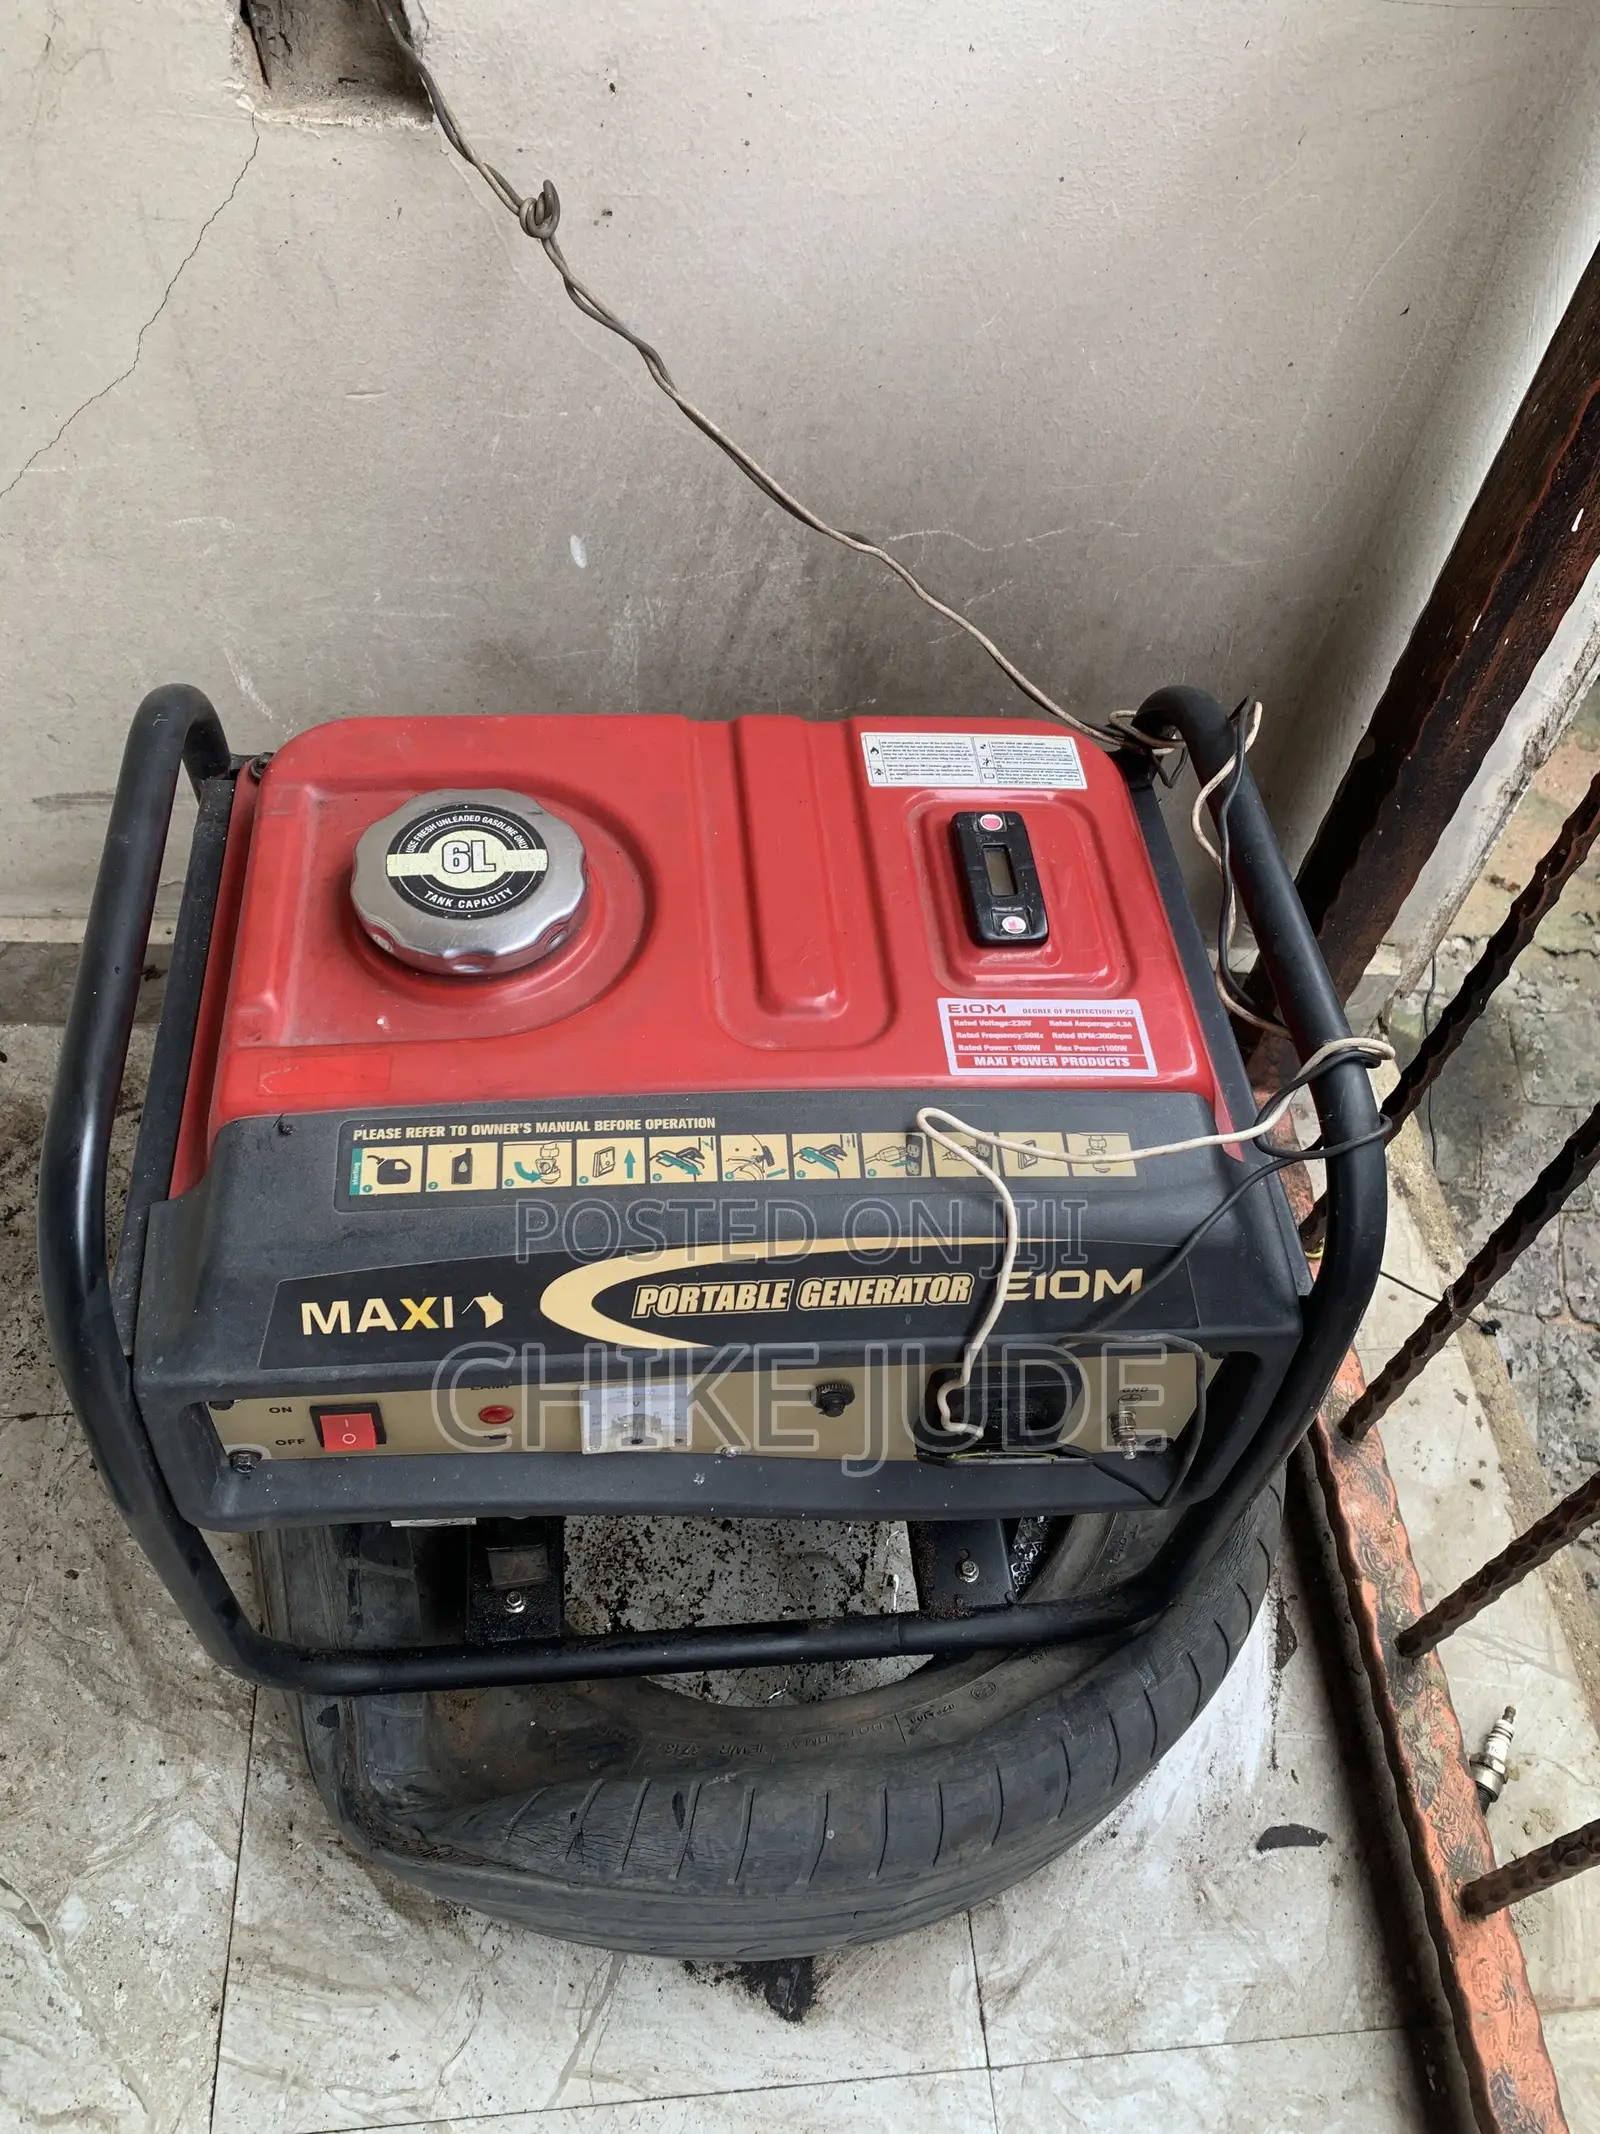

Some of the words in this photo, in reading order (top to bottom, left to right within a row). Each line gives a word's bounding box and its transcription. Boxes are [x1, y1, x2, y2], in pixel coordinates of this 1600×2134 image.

[405, 840, 419, 854] USE
[414, 824, 438, 843] FRESH
[435, 814, 481, 827] UNLEADED
[481, 816, 519, 837] GASOLINE
[514, 834, 530, 850] ONLY
[441, 839, 497, 875] 6L
[423, 890, 454, 908] TANK
[457, 887, 514, 909] CAPACITY
[953, 1019, 978, 1027] Rated
[974, 1056, 1008, 1066] MAXI
[1011, 1056, 1059, 1067] POWER
[1060, 1056, 1131, 1068] PRODUCTS
[353, 1128, 402, 1141] PLEASE
[405, 1126, 445, 1139] REFER
[449, 1125, 467, 1137] TO
[471, 1122, 532, 1136] OWNER'S
[535, 1120, 591, 1134] MANUAL
[594, 1119, 642, 1132] BEFORE
[645, 1117, 716, 1130] OPERATION
[632, 1279, 795, 1319] PORTABLE
[798, 1274, 975, 1310] GENERATOR
[301, 1296, 454, 1336] MAXI
[268, 1406, 293, 1414] ON
[275, 1438, 306, 1447] OFF
